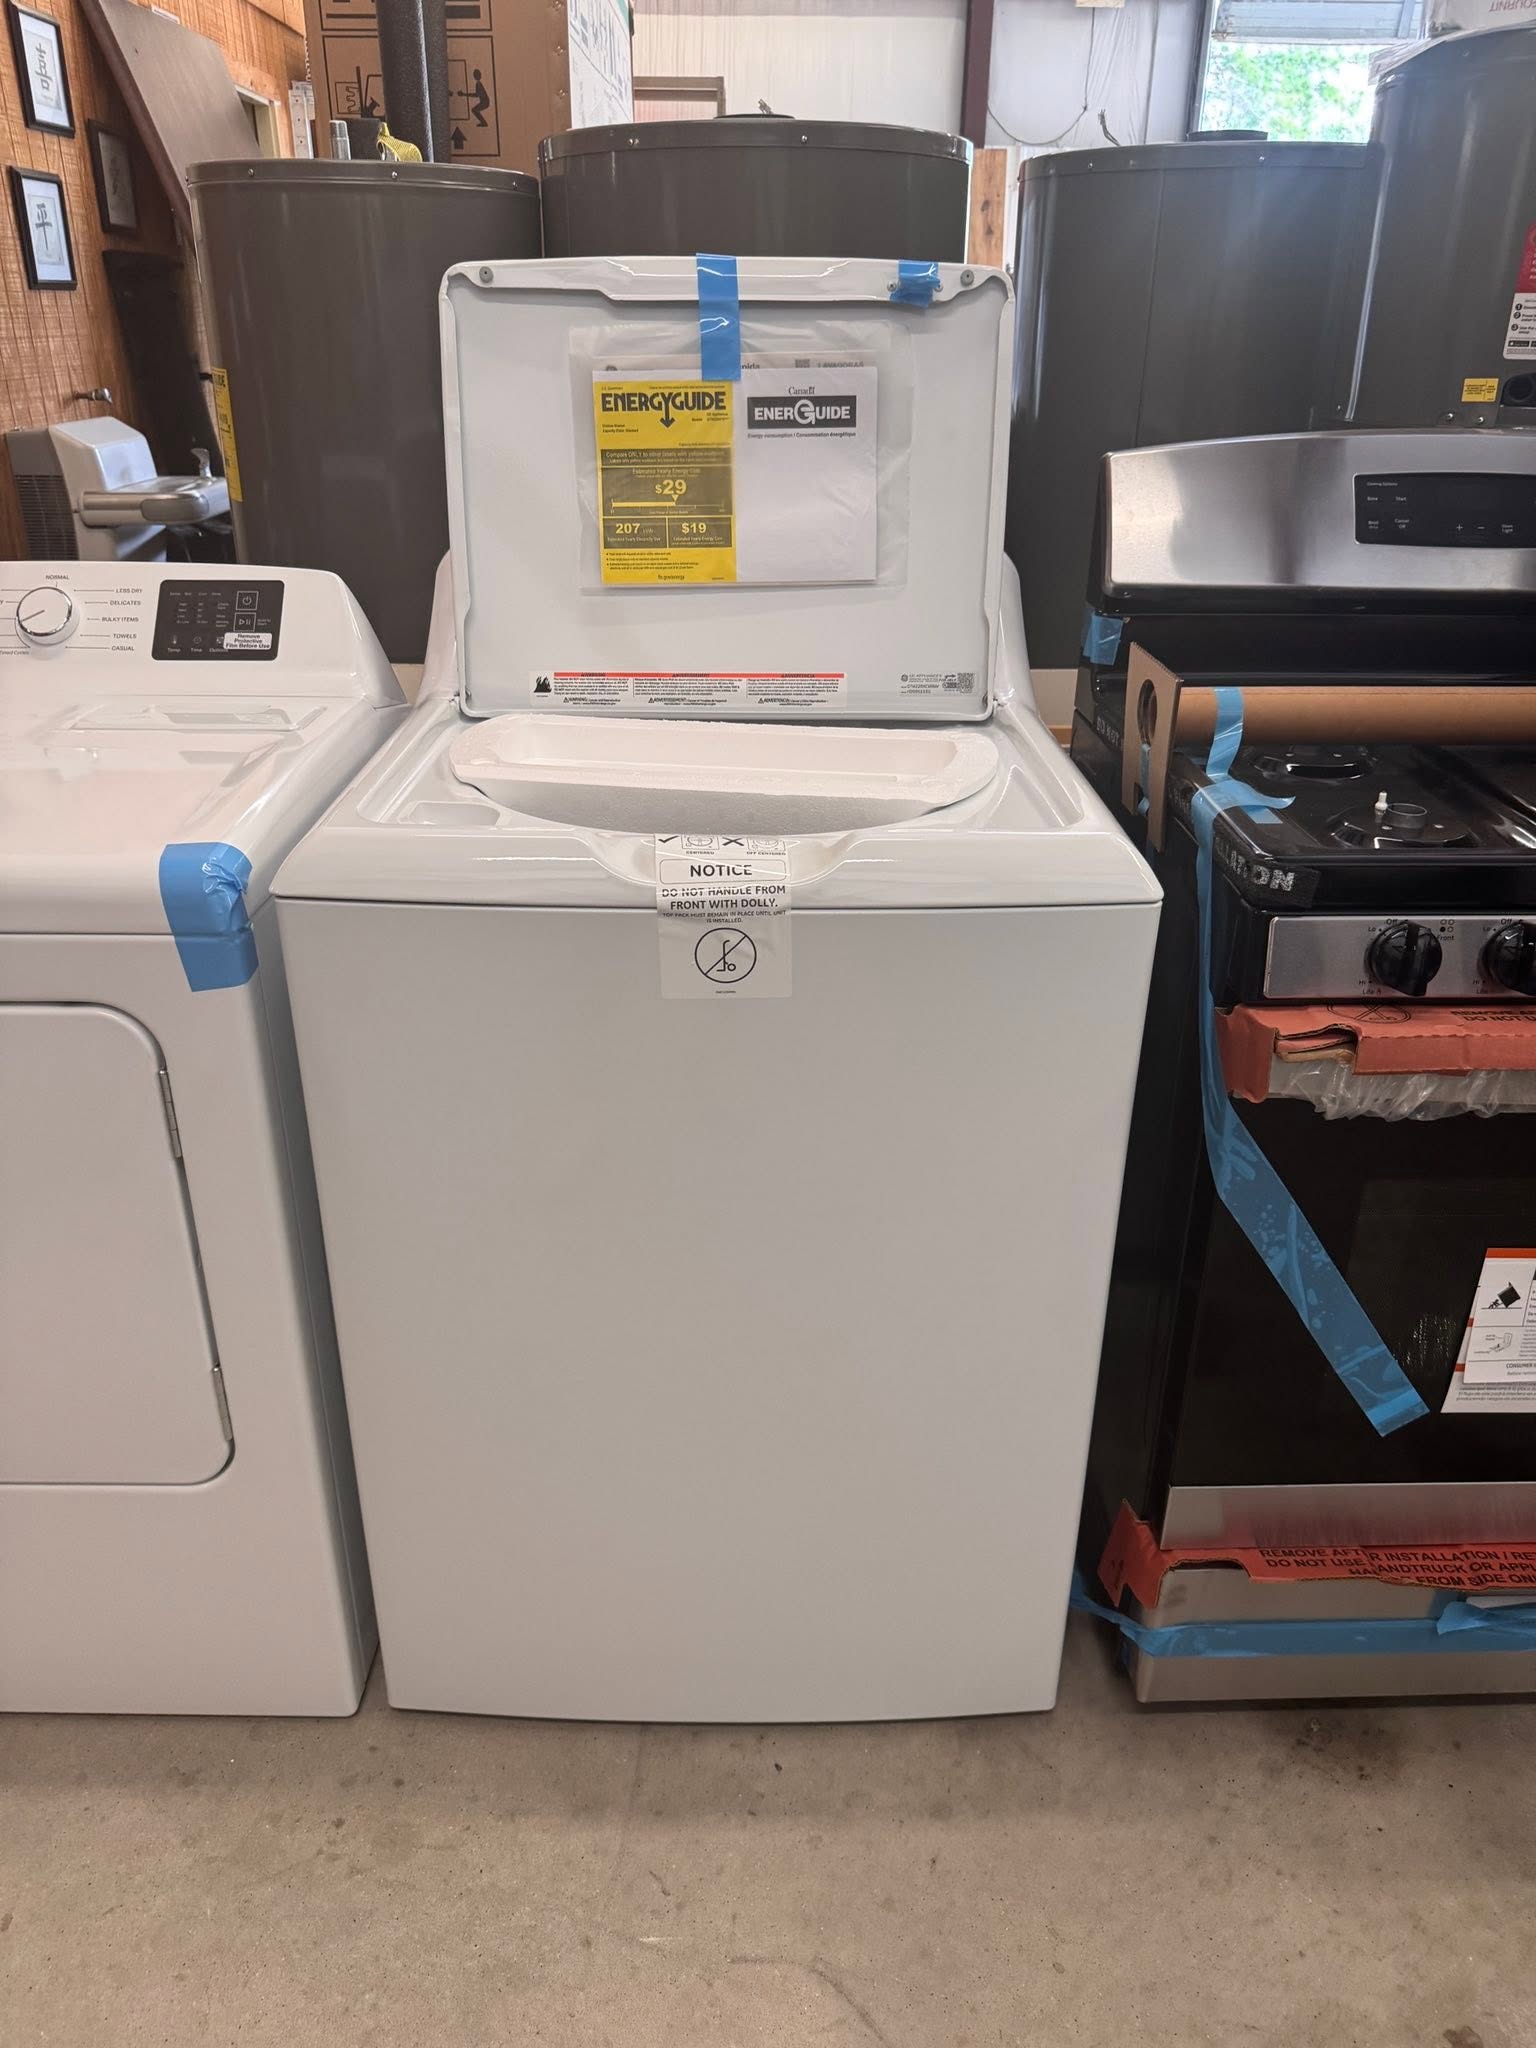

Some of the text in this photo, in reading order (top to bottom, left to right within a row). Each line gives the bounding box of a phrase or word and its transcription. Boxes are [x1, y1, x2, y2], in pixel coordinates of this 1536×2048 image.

[600, 391, 727, 419] ENERGYGUIDE
[754, 399, 851, 425] ENERGUIDE
[655, 479, 687, 495] $29
[615, 522, 641, 535] 207
[681, 522, 707, 535] $19
[690, 864, 753, 877] NOTICE
[661, 885, 786, 898] DO NOT HANDLE FROM
[670, 898, 778, 911] FRONT WITH DOLLY.
[1259, 1549, 1329, 1558] REMOVE
[1384, 1550, 1500, 1562] INSTALLATION
[1511, 1551, 1536, 1561] RE
[1265, 1559, 1291, 1567] DO
[1294, 1559, 1330, 1567] NOT
[1330, 1559, 1367, 1567] USE
[1469, 1561, 1496, 1572] OR
[1499, 1562, 1536, 1572] APPL
[1415, 1576, 1467, 1586] FROM
[1467, 1574, 1507, 1586] SIDE
